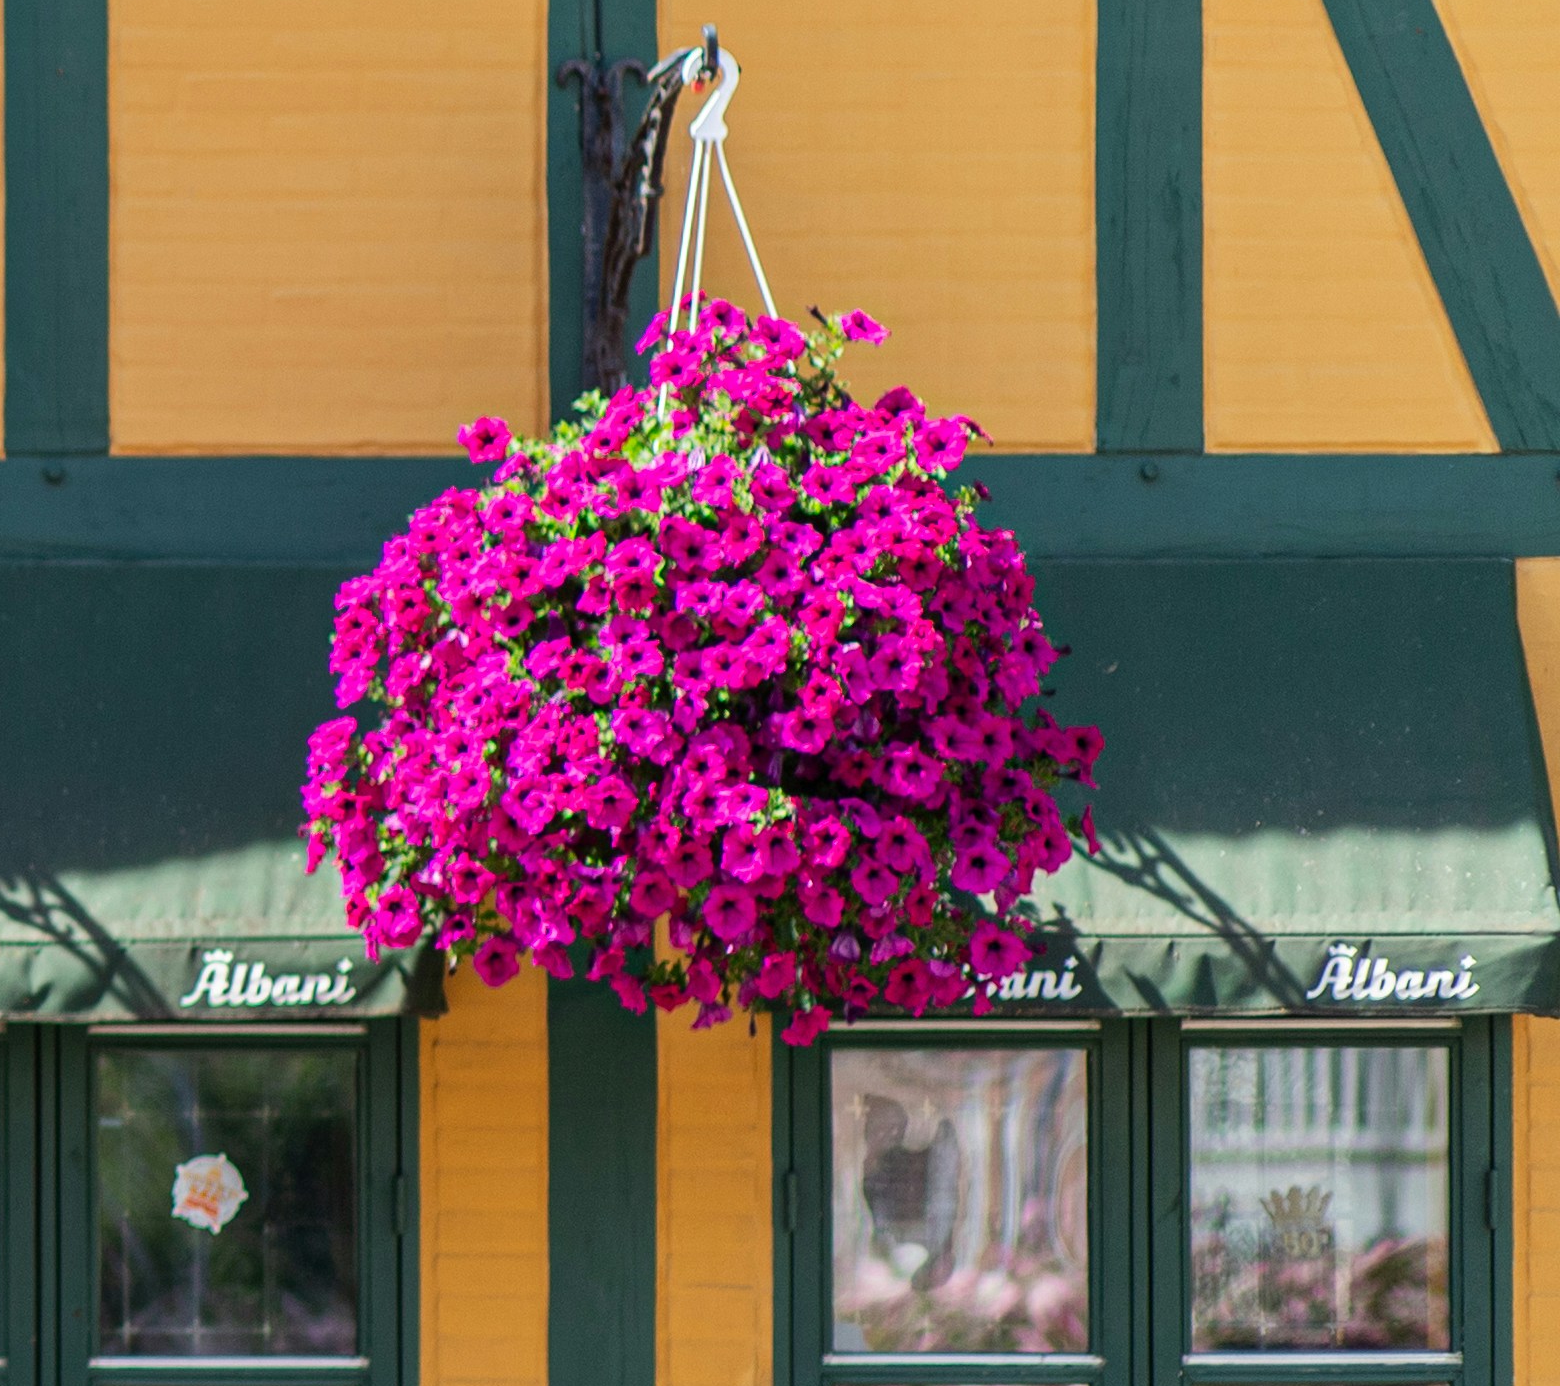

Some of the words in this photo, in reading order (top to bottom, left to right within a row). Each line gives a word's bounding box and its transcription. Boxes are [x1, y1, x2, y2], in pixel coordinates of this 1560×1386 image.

[180, 949, 357, 1007] Albani
[960, 957, 1084, 1000] ani
[1307, 944, 1481, 1000] Albani
